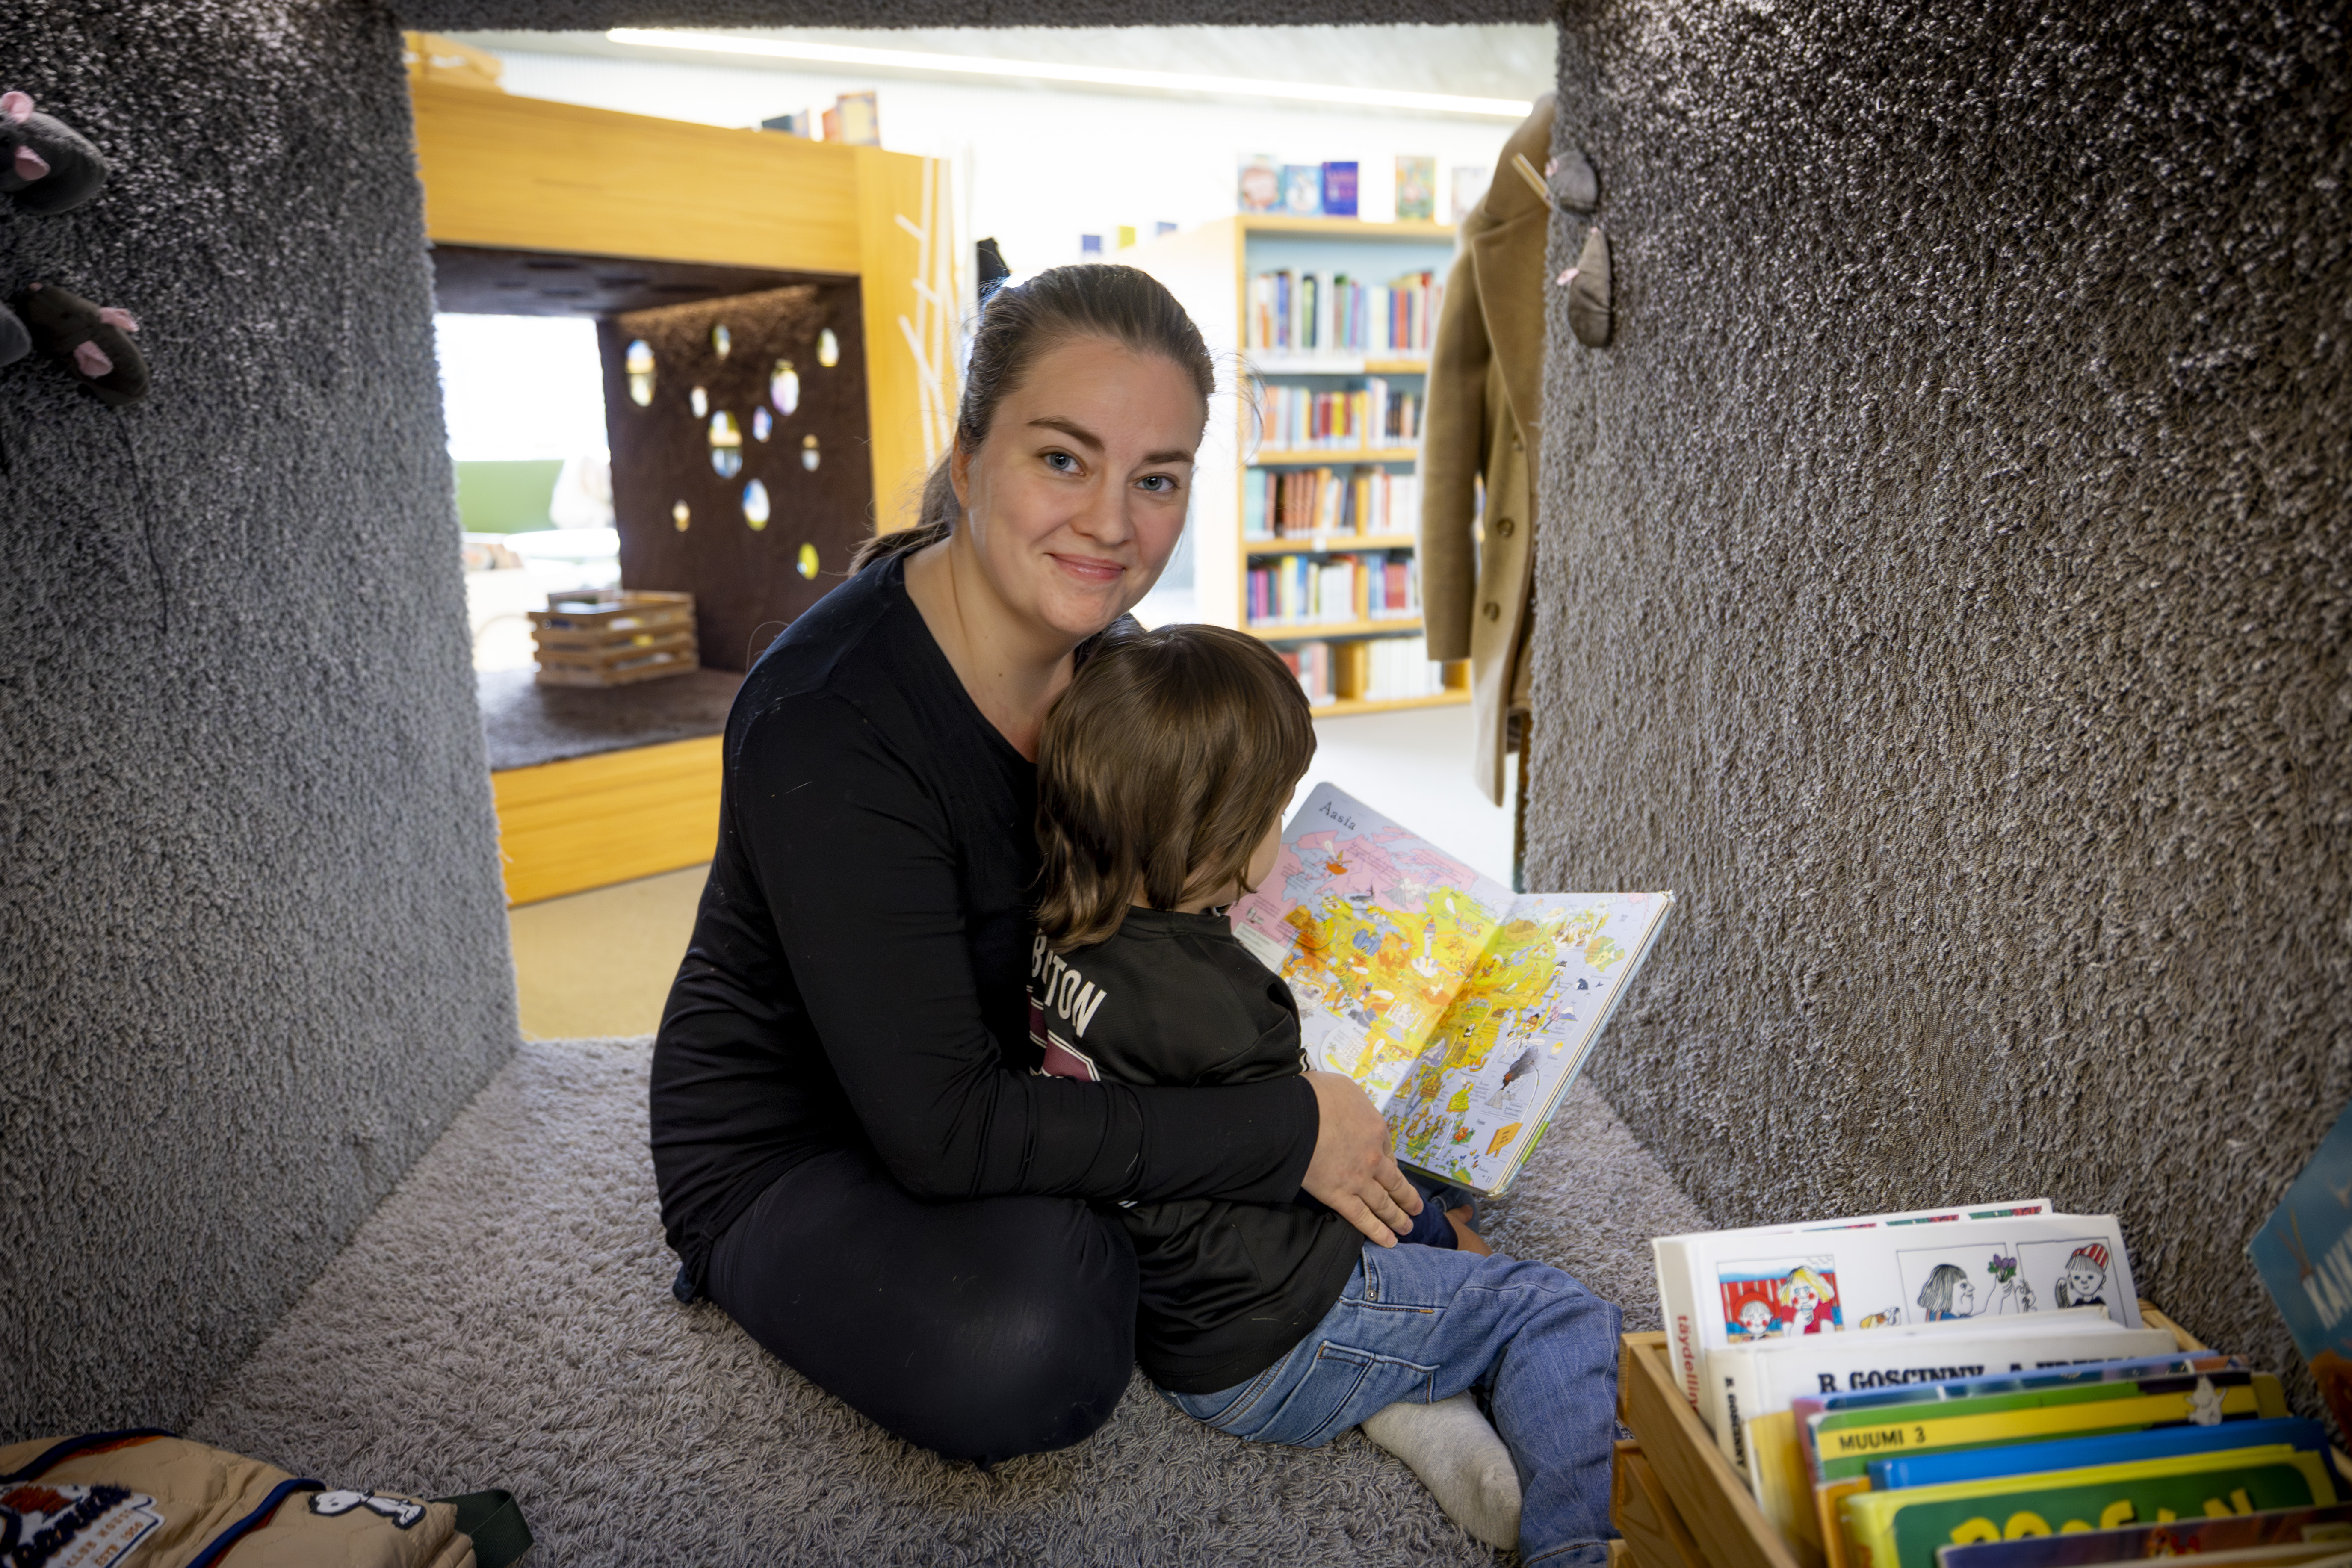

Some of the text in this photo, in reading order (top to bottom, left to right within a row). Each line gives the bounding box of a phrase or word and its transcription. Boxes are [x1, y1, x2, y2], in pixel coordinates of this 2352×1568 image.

[1318, 801, 1356, 830] Aasia
[1839, 1425, 1926, 1451] MUUMI 3
